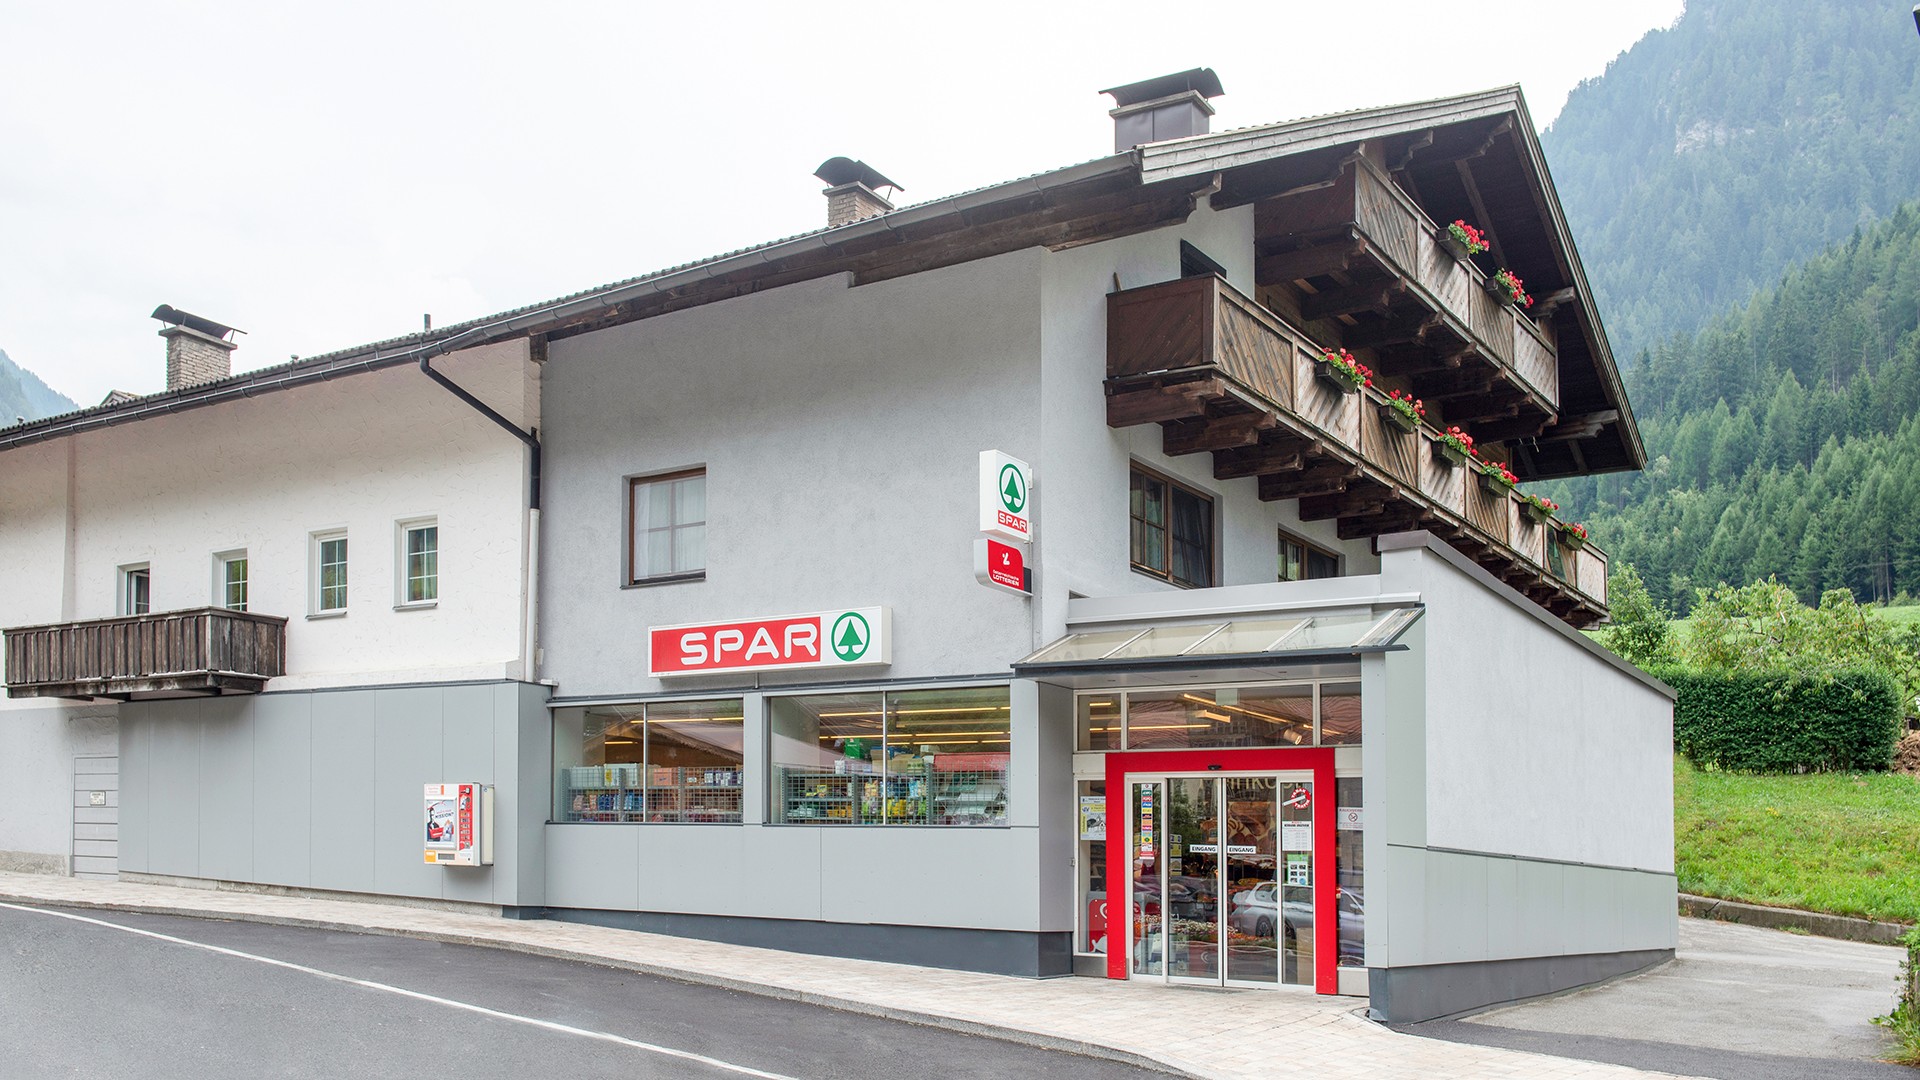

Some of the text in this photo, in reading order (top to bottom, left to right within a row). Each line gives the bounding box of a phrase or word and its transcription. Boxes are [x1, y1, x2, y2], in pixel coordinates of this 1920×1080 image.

[998, 512, 1027, 532] SPAR
[992, 573, 1019, 586] LOTTERIEN
[680, 623, 818, 665] SPAR
